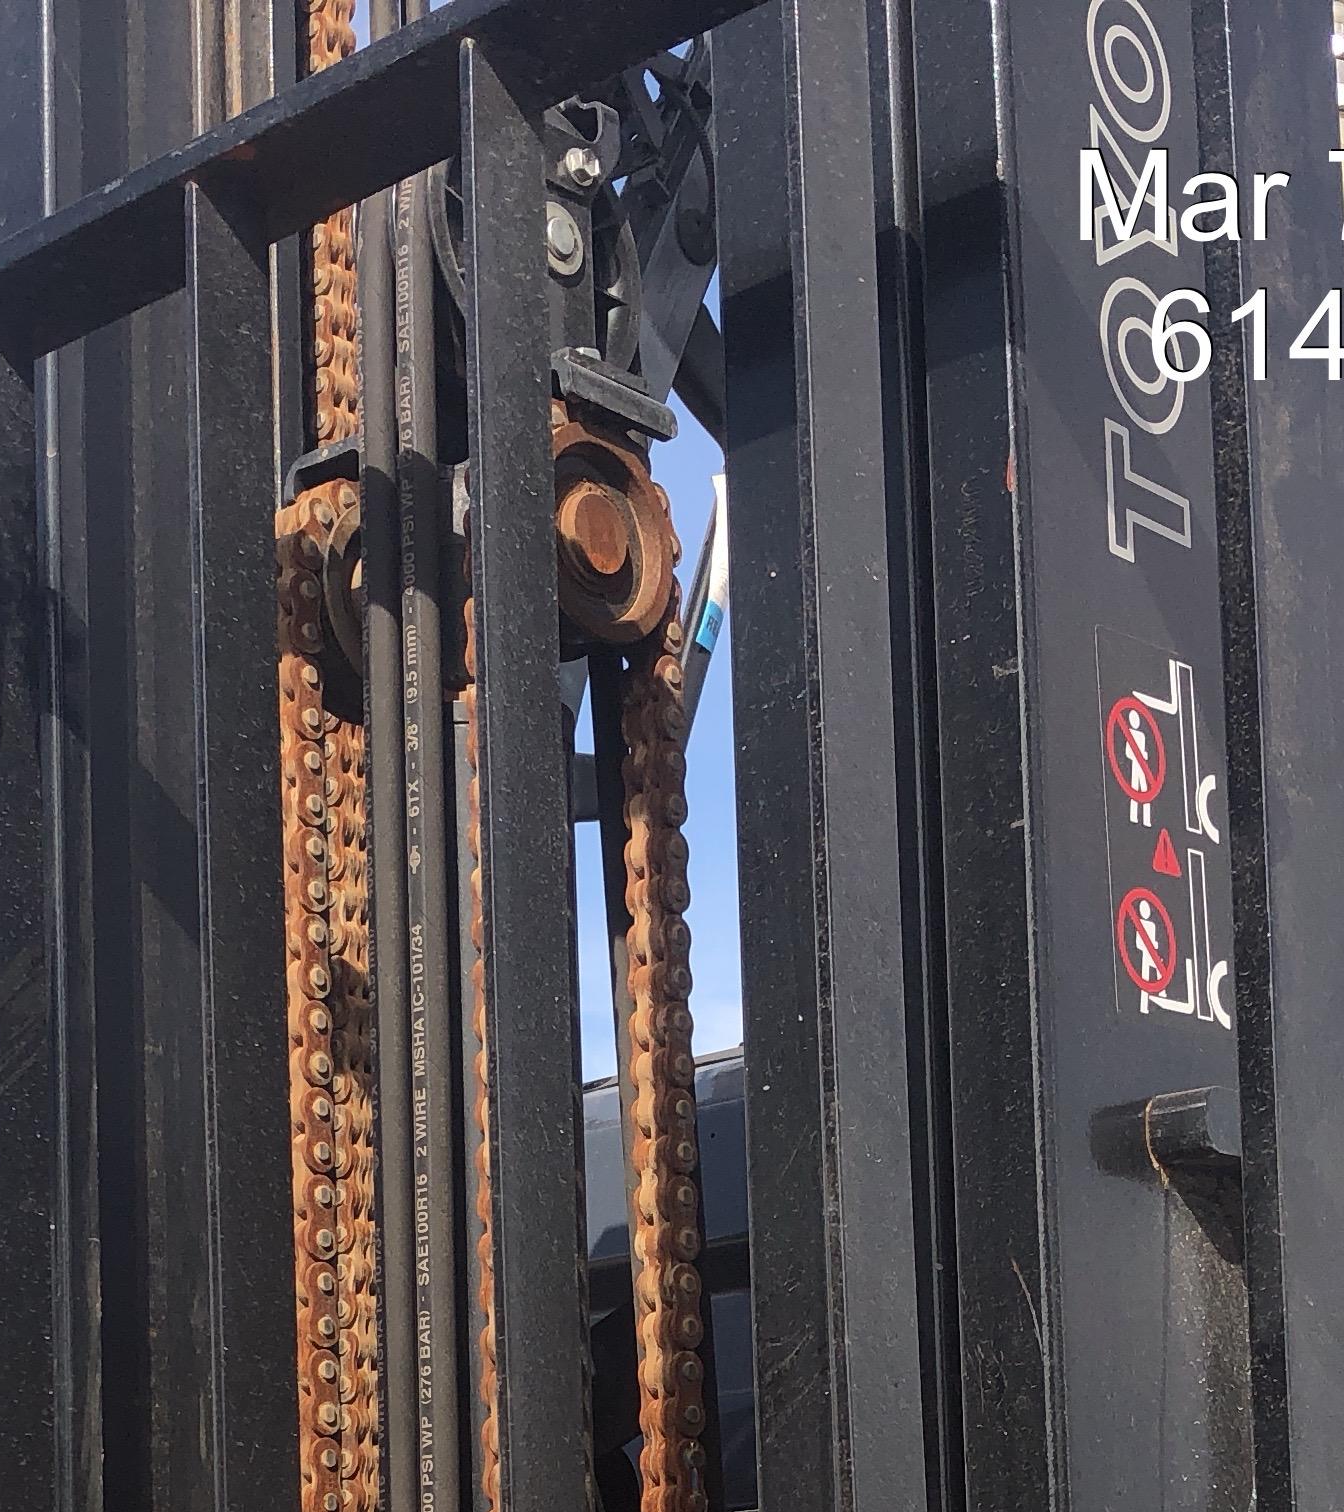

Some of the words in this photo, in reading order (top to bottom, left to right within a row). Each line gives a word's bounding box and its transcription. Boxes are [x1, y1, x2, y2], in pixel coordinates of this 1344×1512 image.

[410, 922, 425, 1012] IC-101/34
[413, 1018, 426, 1076] MSHA
[414, 1087, 428, 1142] WIRE
[416, 1173, 430, 1287] SAE100R16
[418, 1310, 432, 1361] BAR)
[418, 1364, 433, 1404] (276
[420, 1416, 434, 1448] WP
[421, 1453, 434, 1487] PSI
